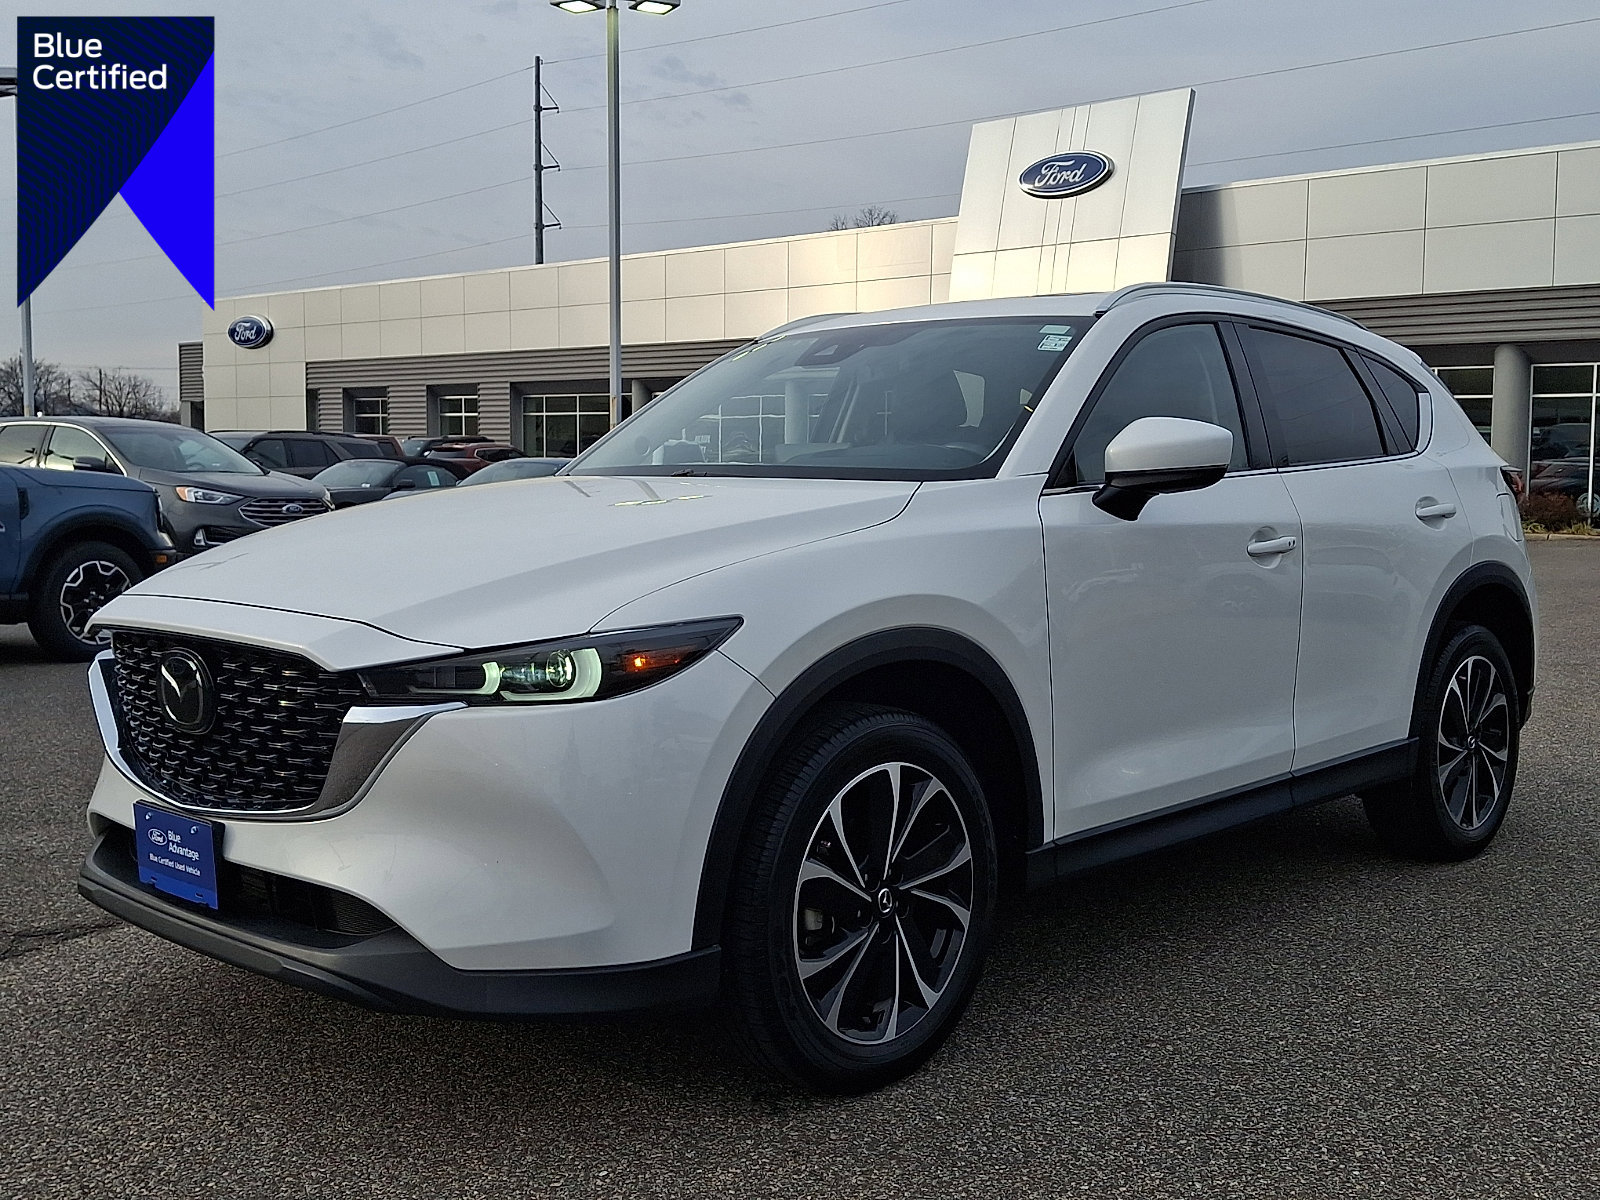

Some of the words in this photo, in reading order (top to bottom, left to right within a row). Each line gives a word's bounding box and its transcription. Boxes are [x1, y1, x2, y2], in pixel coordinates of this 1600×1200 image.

[1034, 159, 1088, 187] Ford
[234, 322, 257, 341] Ford
[168, 830, 181, 843] Blue
[168, 842, 200, 861] Advantage
[175, 862, 185, 871] Used
[186, 864, 200, 876] Vehicle
